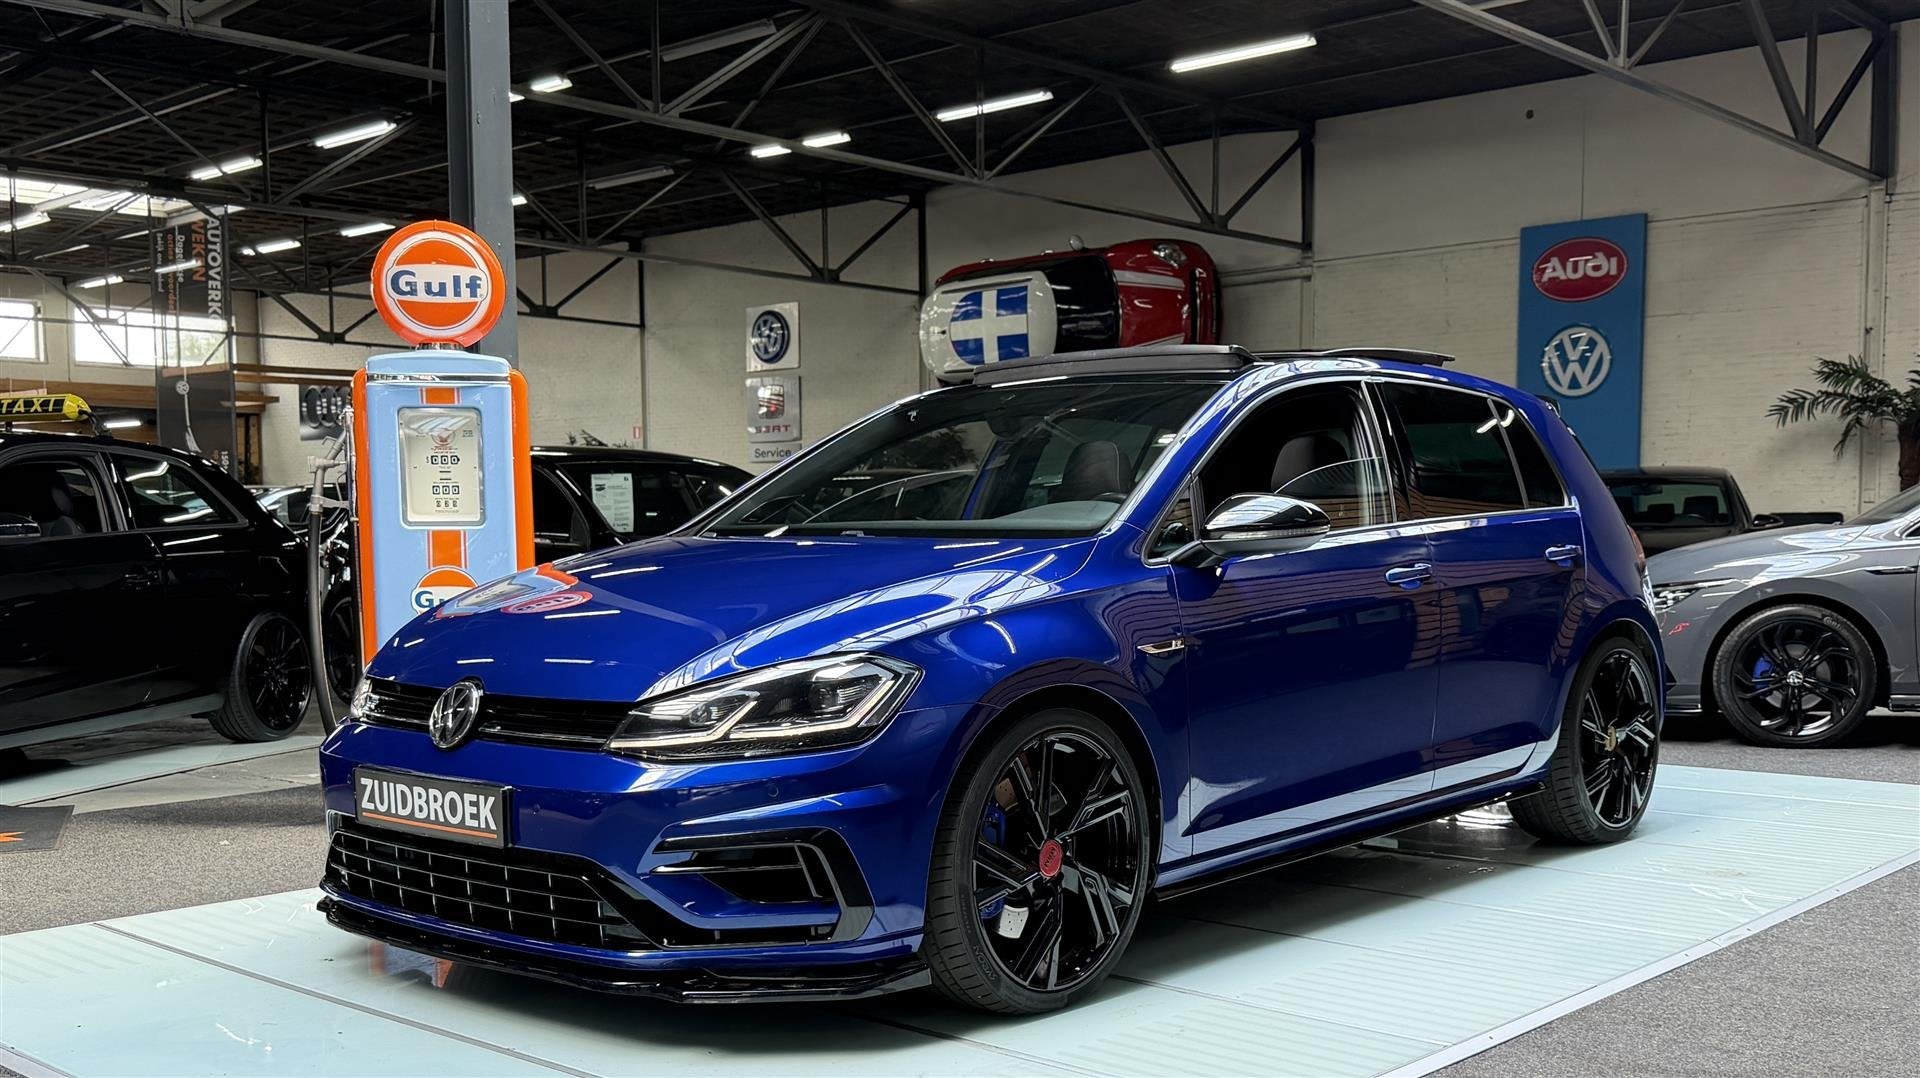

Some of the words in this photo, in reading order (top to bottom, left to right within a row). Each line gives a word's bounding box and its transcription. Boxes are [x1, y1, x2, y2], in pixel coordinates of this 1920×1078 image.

[390, 269, 482, 298] Gulf
[1, 397, 55, 413] TAXI
[755, 447, 792, 459] Service
[360, 777, 498, 830] ZUIDBROEK
